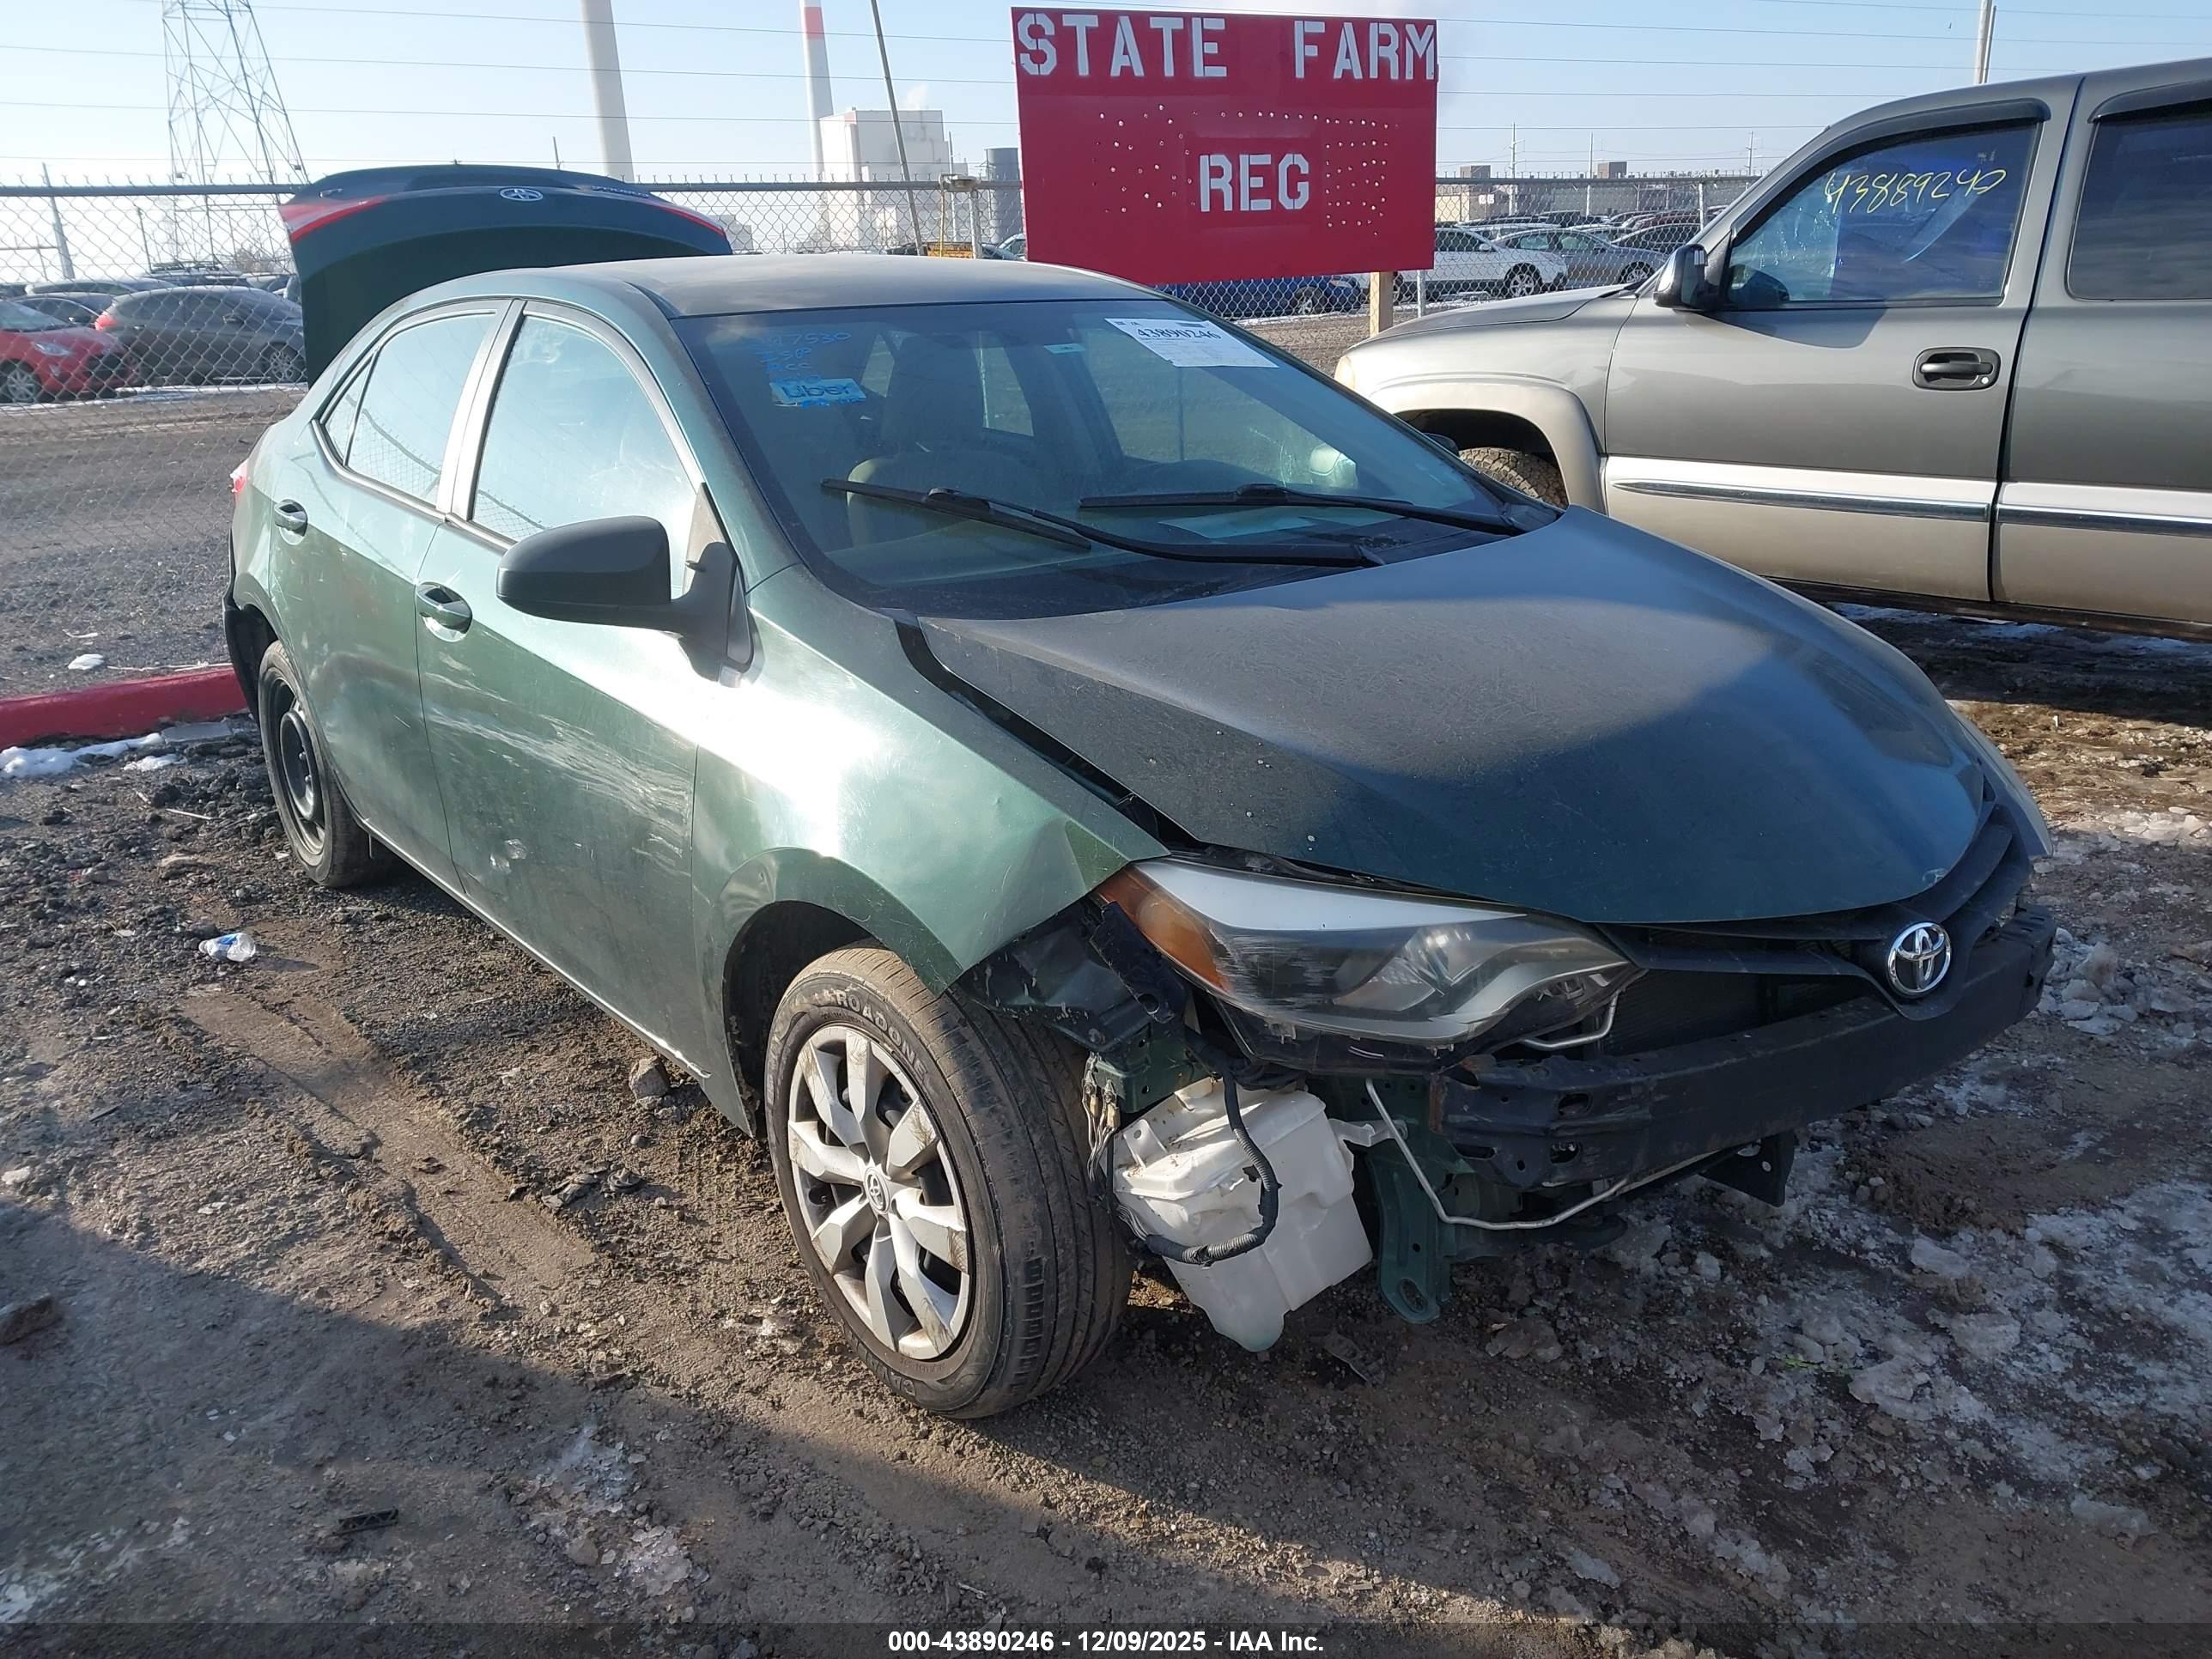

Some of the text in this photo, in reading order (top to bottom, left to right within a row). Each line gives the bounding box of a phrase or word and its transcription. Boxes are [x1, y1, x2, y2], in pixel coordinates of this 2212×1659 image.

[1018, 12, 1436, 82] STATE FARM
[1198, 153, 1310, 212] REG
[1137, 327, 1223, 340] 43890246
[836, 989, 928, 1082] ROADONE
